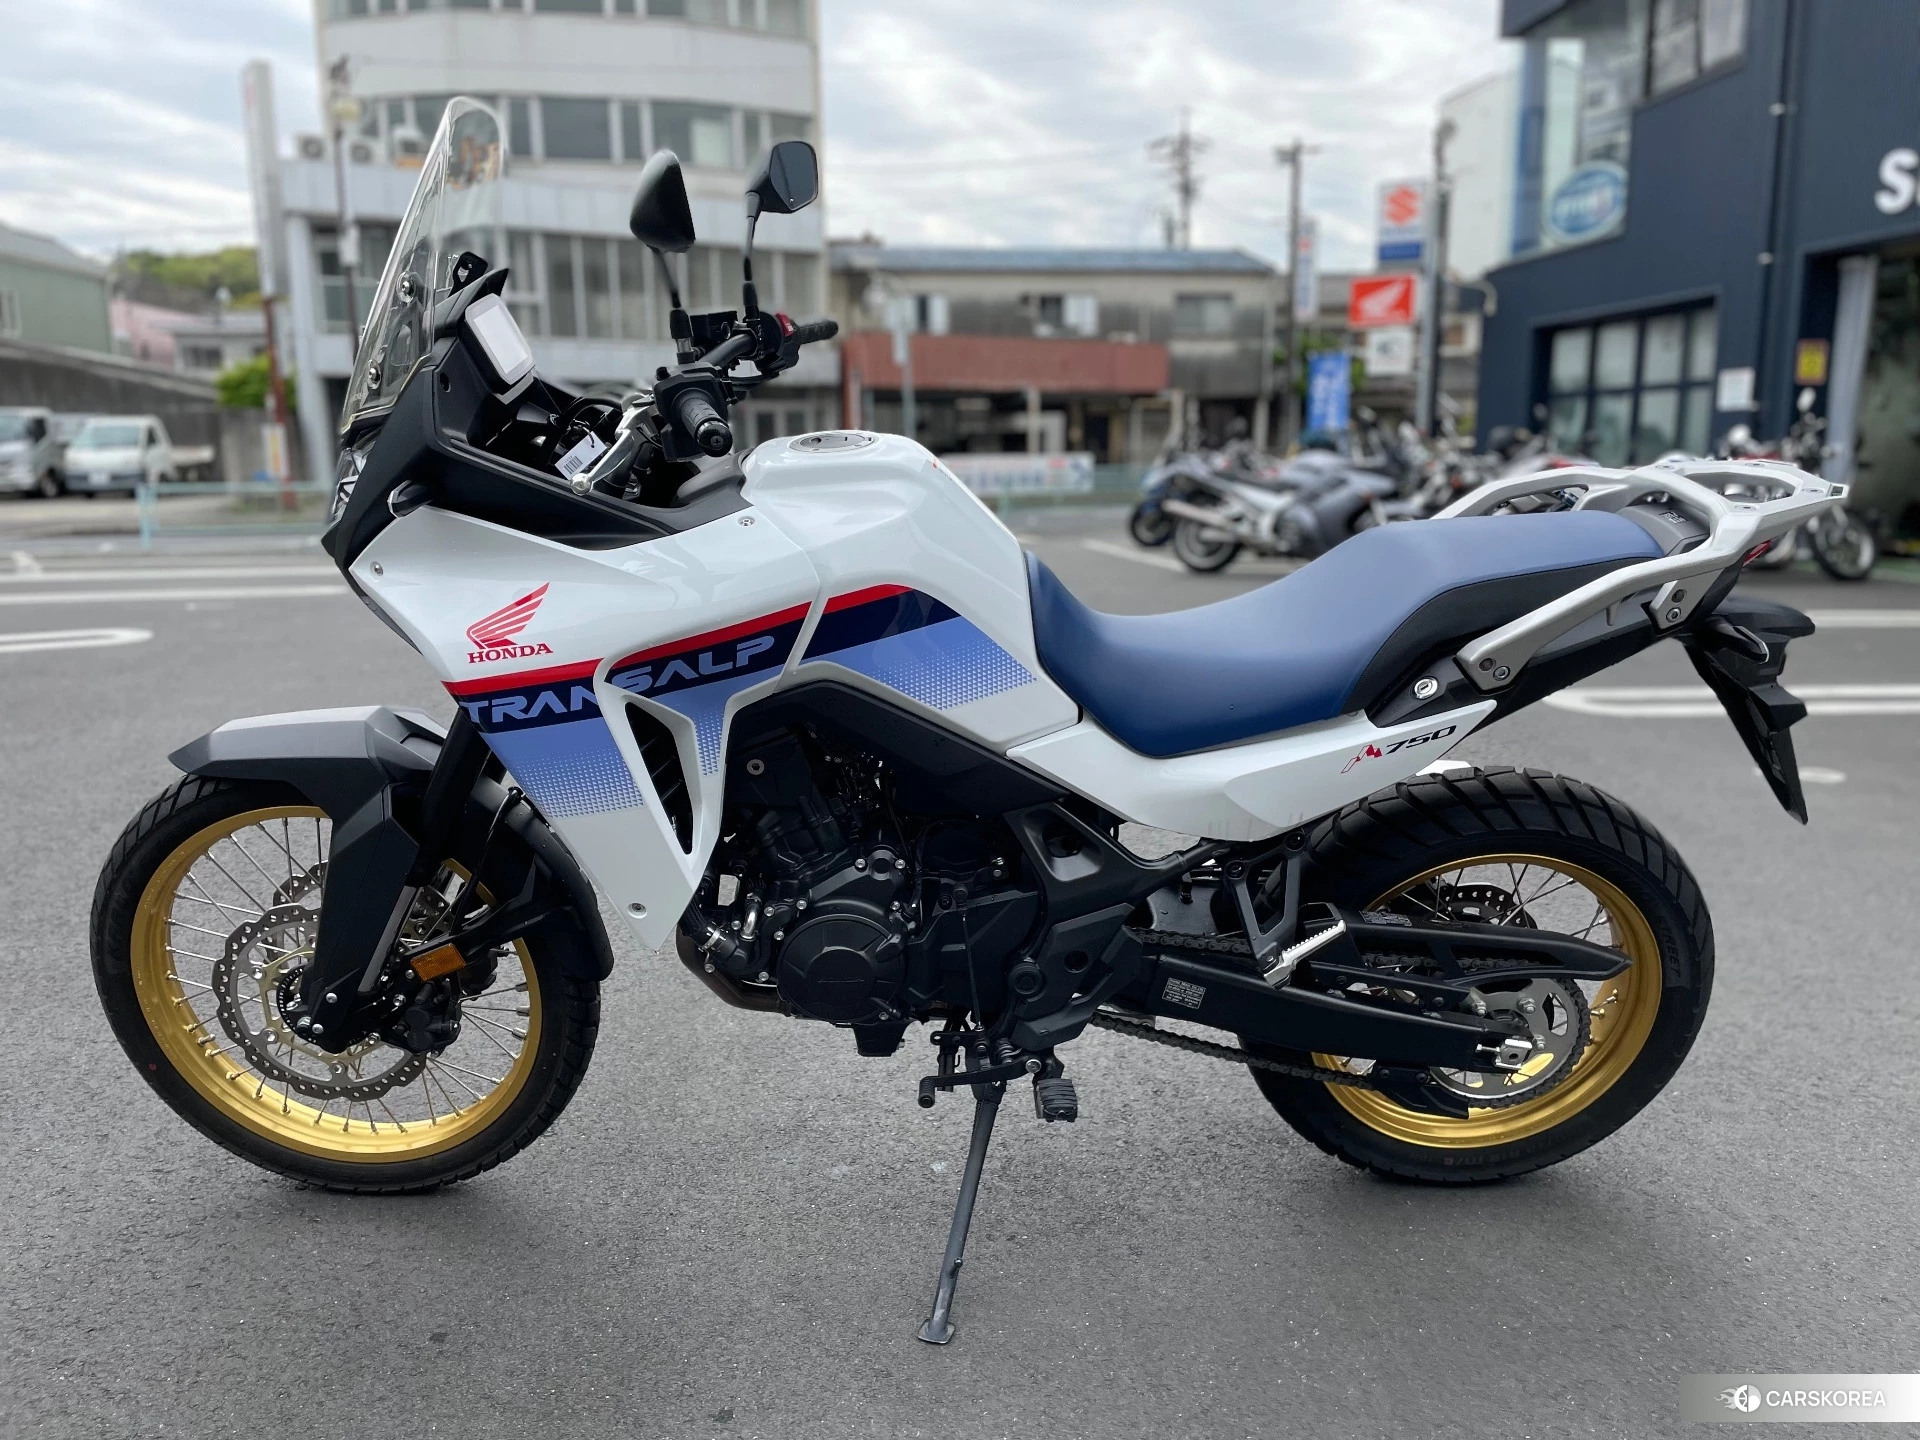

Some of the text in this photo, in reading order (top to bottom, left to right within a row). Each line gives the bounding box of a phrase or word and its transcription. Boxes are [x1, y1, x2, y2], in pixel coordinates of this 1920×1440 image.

[1874, 147, 1920, 215] S
[467, 643, 553, 664] HONDA
[1386, 725, 1457, 755] 750
